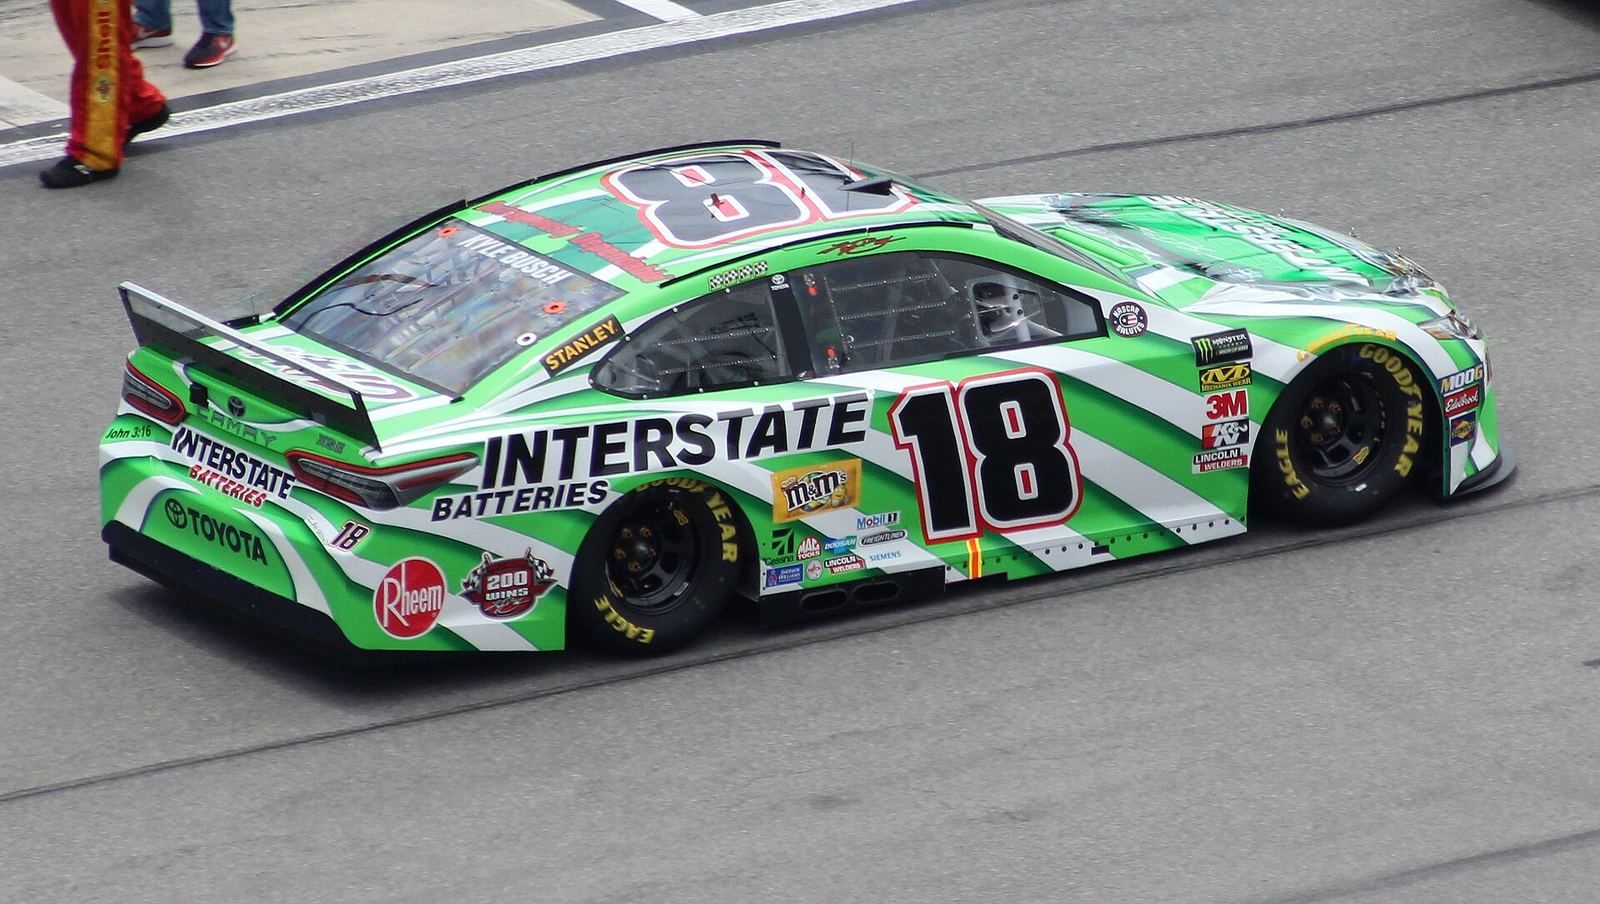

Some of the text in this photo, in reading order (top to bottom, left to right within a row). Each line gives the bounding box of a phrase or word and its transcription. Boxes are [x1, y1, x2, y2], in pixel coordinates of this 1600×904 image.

[458, 233, 504, 260] KYLE
[500, 248, 574, 285] BUSCH
[1113, 305, 1139, 317] NASCAR
[1116, 322, 1145, 335] SALUTES
[545, 320, 617, 370] STANLEY
[1212, 334, 1247, 346] MONSTER
[1440, 364, 1483, 393] MOOG
[1206, 390, 1248, 420] 3M
[105, 425, 152, 440] John 3:16
[478, 393, 871, 489] INTERSTATE
[172, 427, 297, 499] INTERSTATE
[888, 366, 1083, 545] 18
[1195, 449, 1239, 464] LINCOLN
[1204, 458, 1243, 471] WELDERS
[188, 464, 268, 507] BATTERIES
[430, 479, 609, 522] BATTERIES
[857, 514, 885, 530] Mobil
[187, 507, 268, 566] TOYOTA
[328, 519, 371, 553] 18
[798, 537, 821, 553] MAC
[798, 550, 821, 560] TOOLS
[824, 556, 857, 568] LINCOLN
[869, 551, 901, 562] SIEMENS
[832, 563, 861, 574] WELDERS
[487, 570, 529, 591] 200
[383, 562, 443, 627] Rheem
[485, 587, 529, 600] WINS
[594, 595, 656, 644] EAGLE
